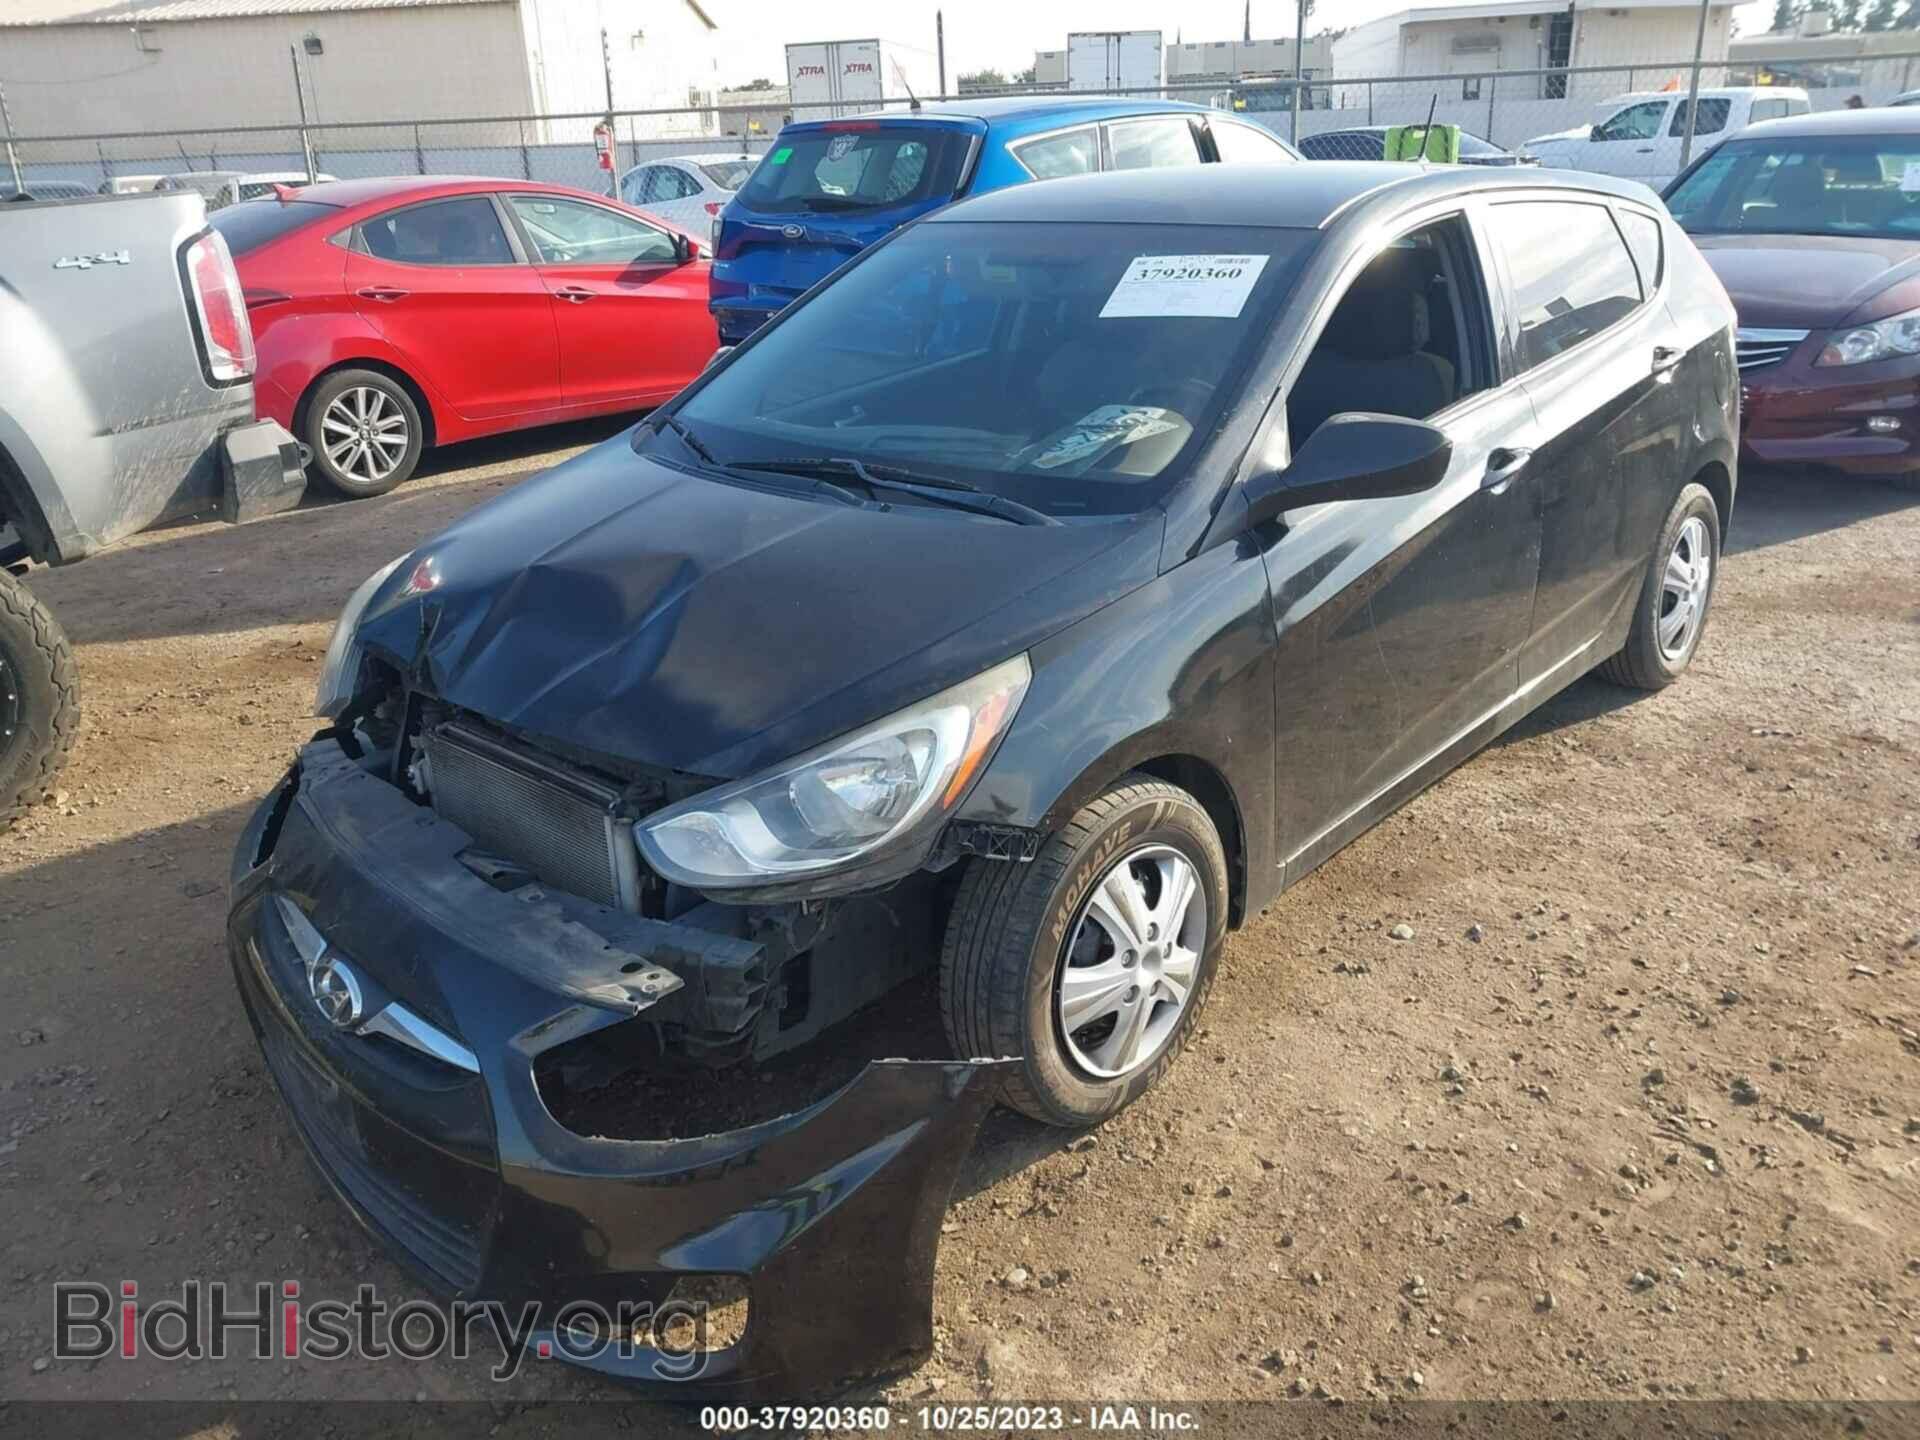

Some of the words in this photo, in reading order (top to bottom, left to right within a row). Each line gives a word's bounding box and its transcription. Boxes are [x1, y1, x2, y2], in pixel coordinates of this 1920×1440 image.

[796, 65, 825, 78] XTRA
[843, 63, 873, 76] XTRA
[1134, 267, 1242, 281] 37920360
[1051, 821, 1132, 943] MOHAVE
